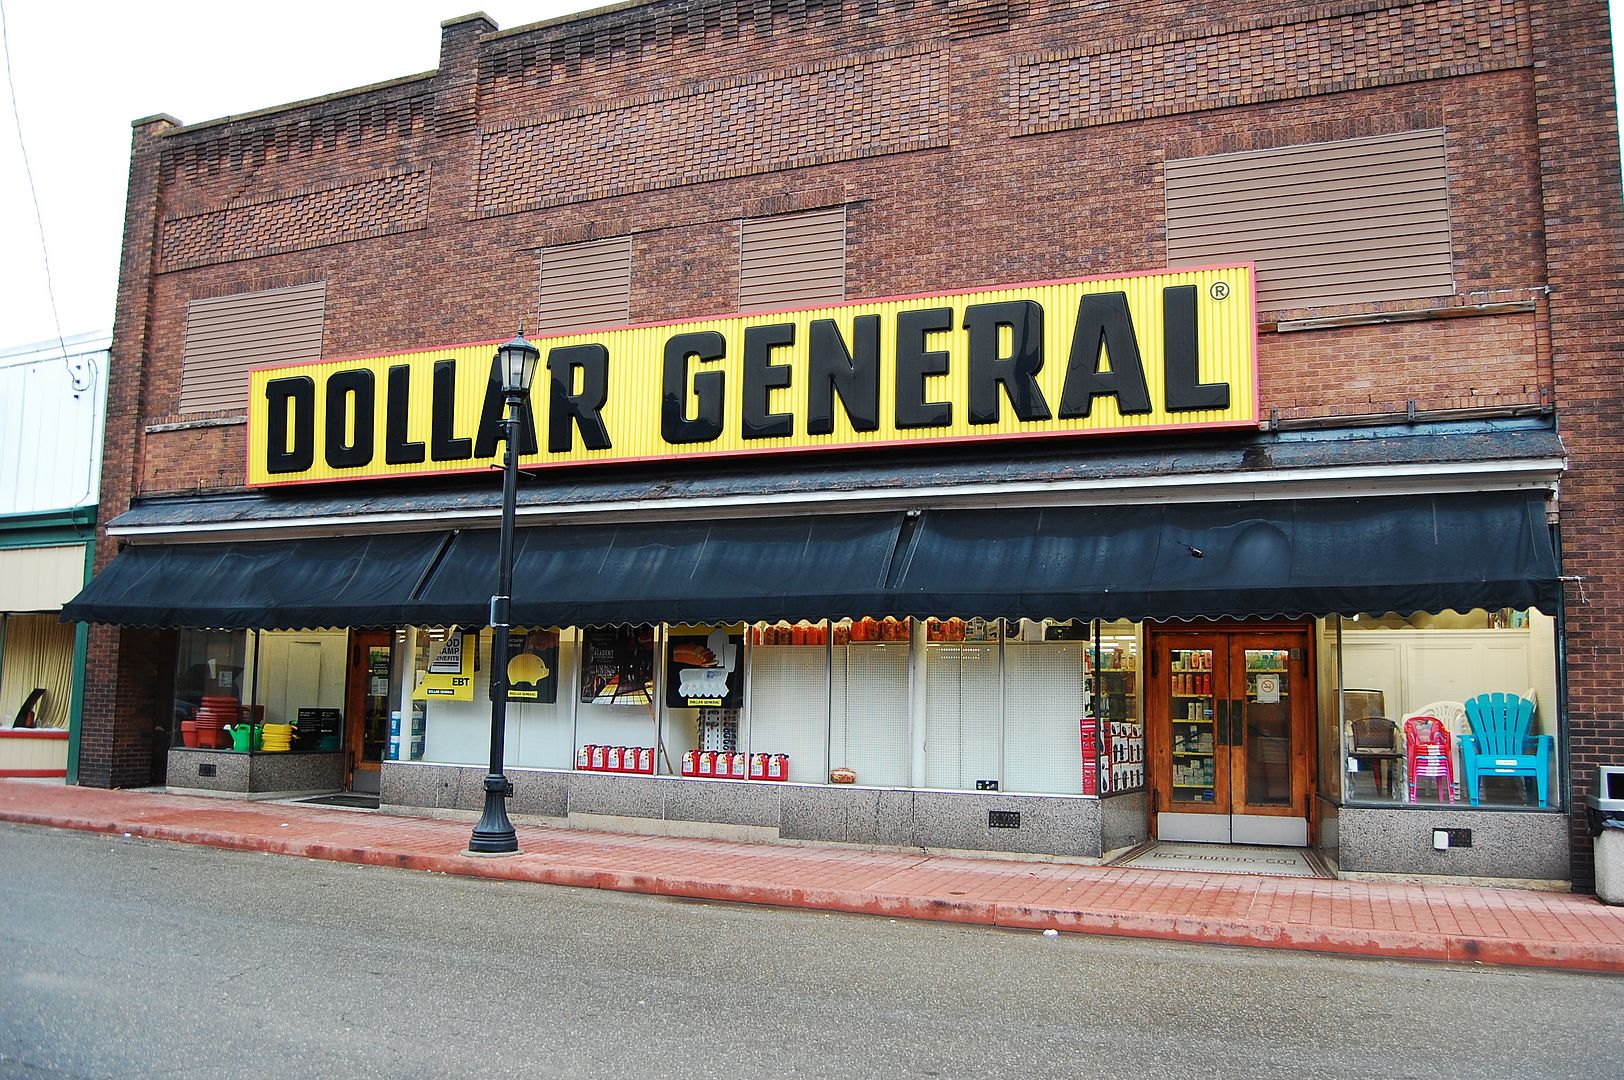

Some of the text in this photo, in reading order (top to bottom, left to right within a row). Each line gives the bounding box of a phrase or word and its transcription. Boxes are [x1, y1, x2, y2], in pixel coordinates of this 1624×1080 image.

[266, 343, 612, 474] DOLLAR
[661, 285, 1230, 444] GENERAL
[452, 677, 470, 686] EBT
